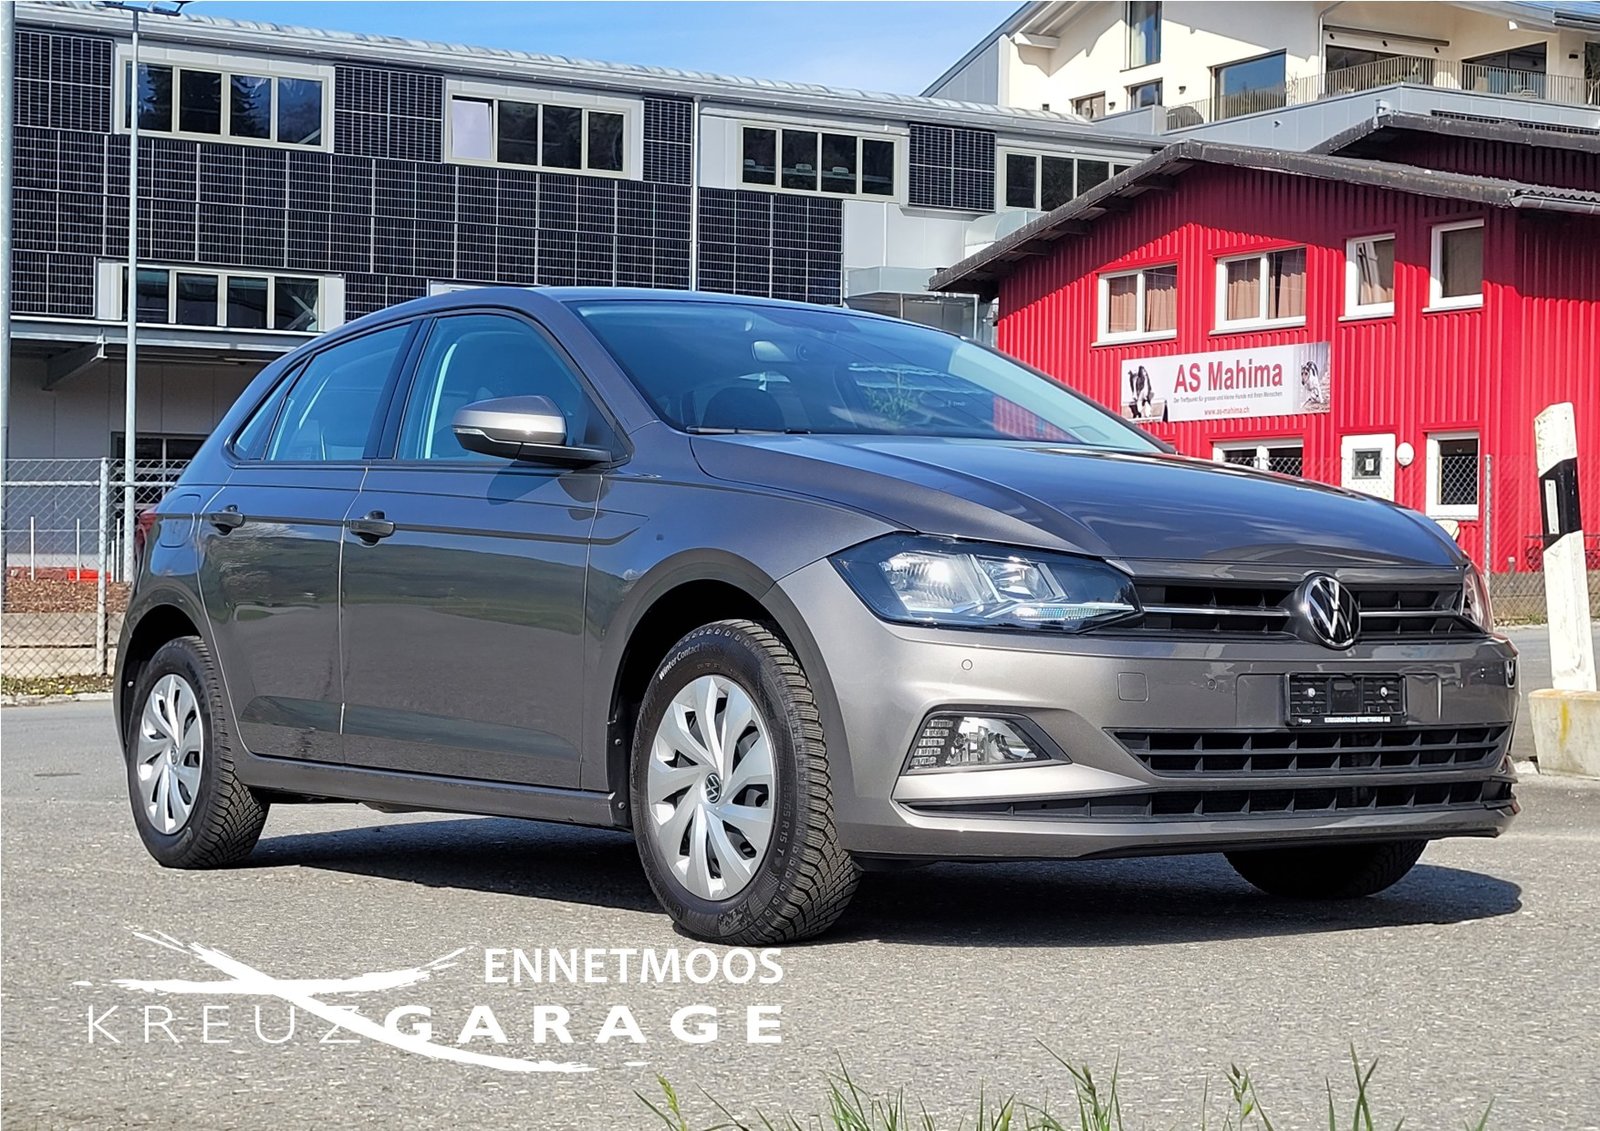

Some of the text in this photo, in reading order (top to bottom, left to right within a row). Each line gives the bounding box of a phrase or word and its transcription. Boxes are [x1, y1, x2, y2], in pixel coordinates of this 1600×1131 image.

[1173, 358, 1283, 394] AS Mahima
[1204, 406, 1249, 416] www.as-mahima.ch
